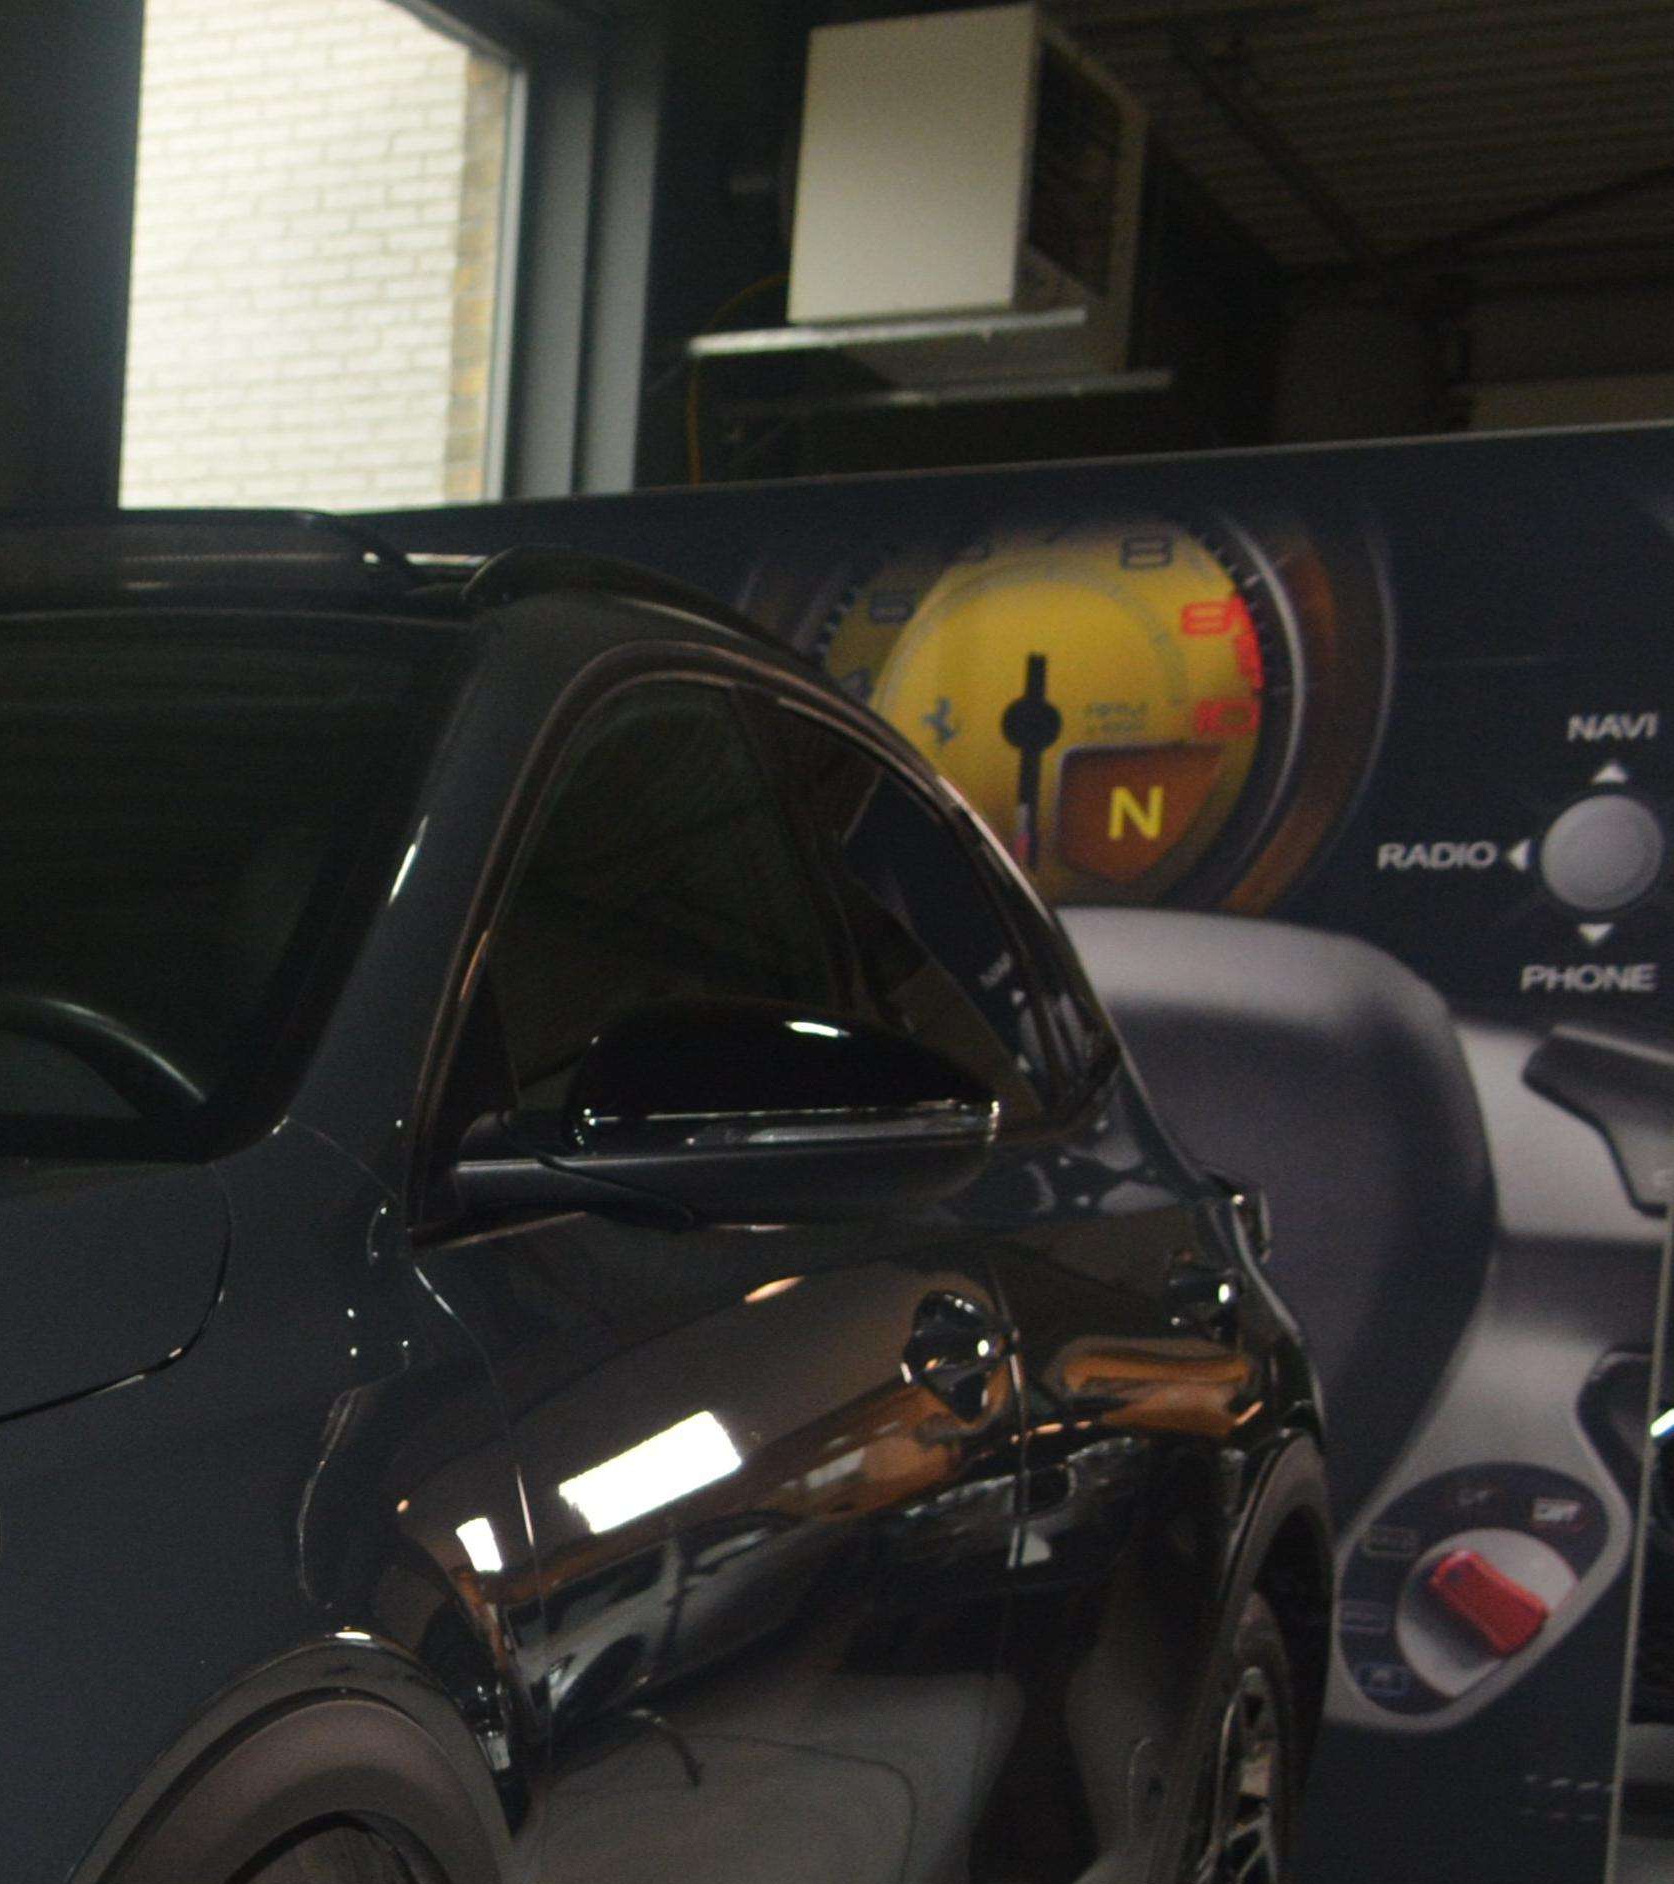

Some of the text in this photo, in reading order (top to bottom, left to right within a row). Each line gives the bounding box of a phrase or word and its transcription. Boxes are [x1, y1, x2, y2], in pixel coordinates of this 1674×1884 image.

[1567, 712, 1659, 742] NAVI
[1107, 785, 1164, 841] N
[1377, 841, 1498, 871] RADIO
[1520, 963, 1657, 993] PHONE
